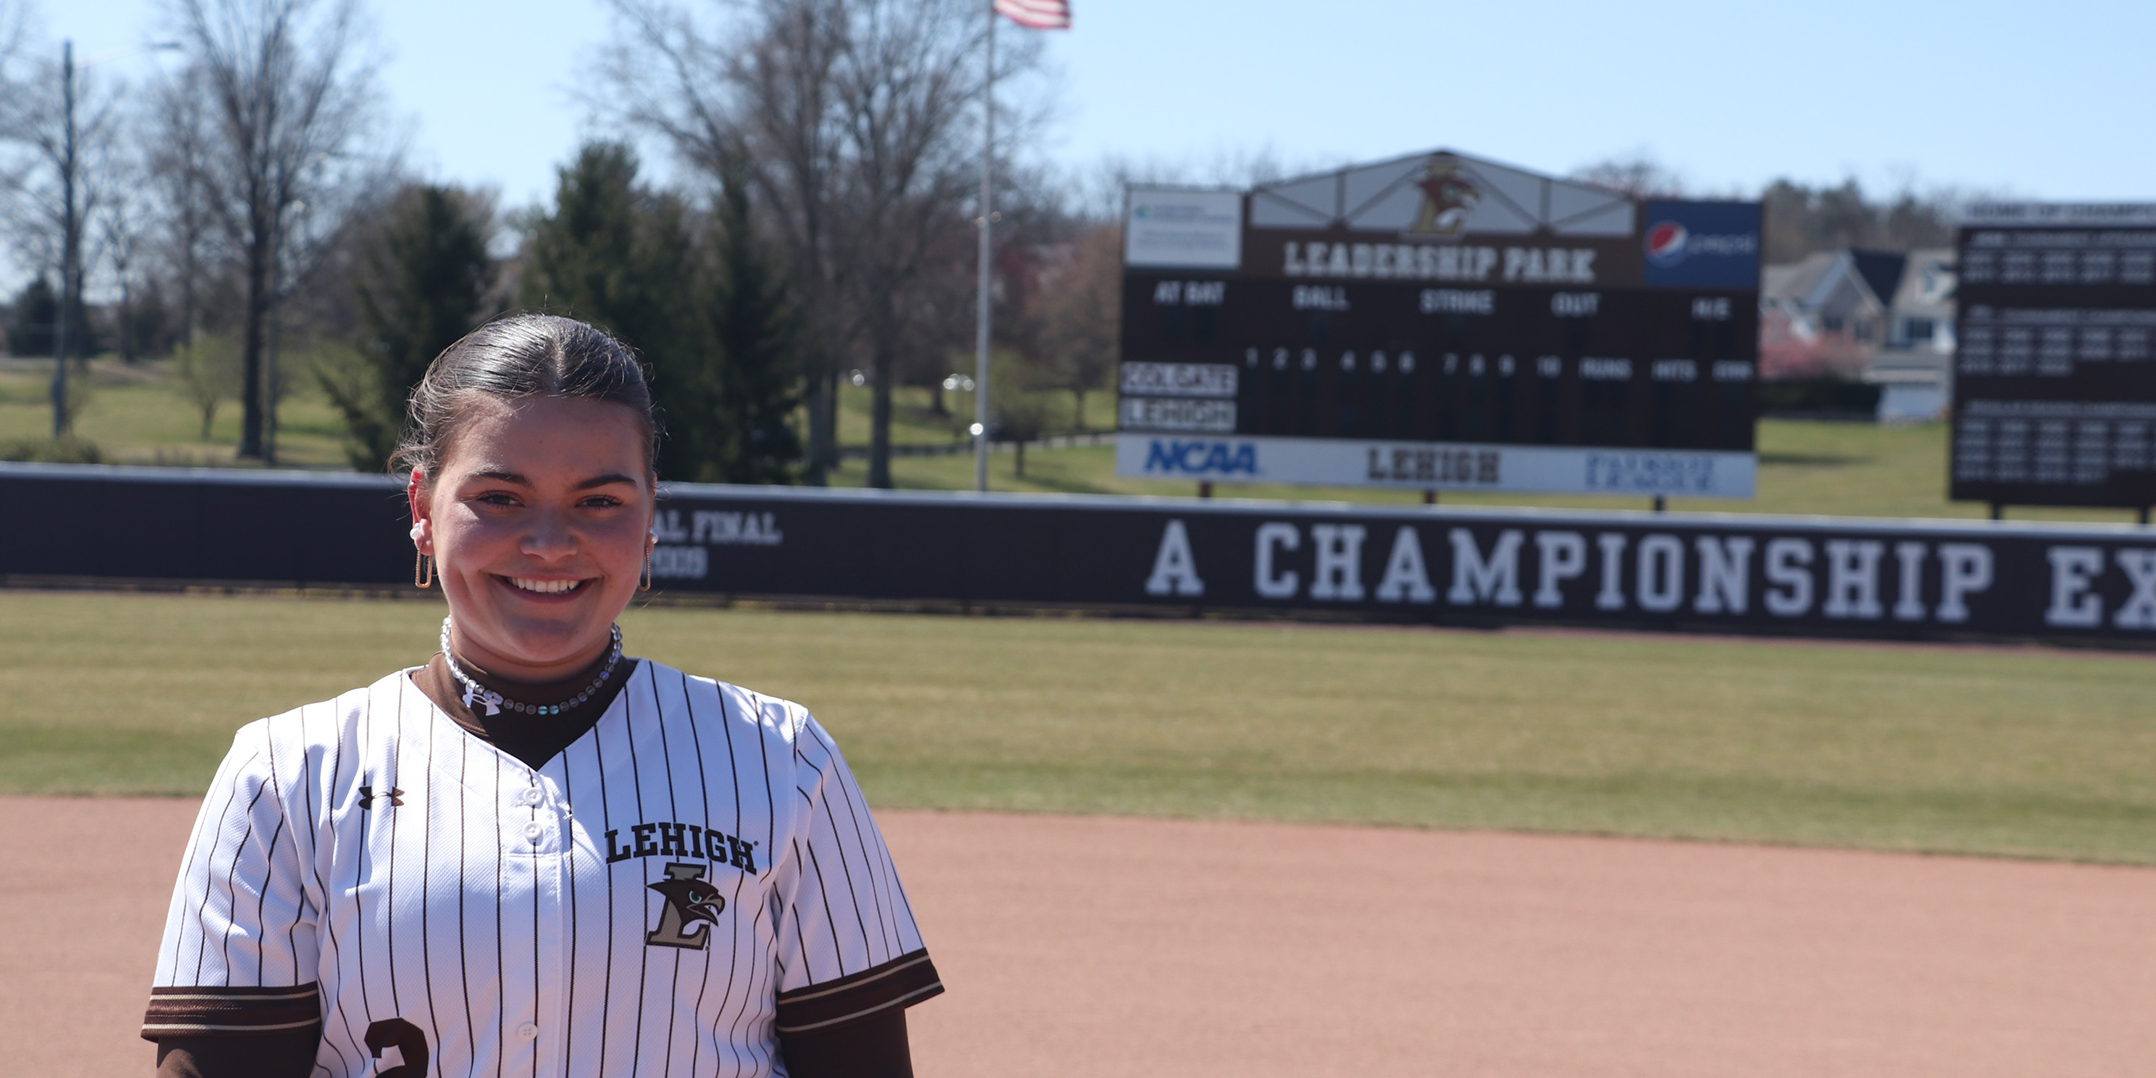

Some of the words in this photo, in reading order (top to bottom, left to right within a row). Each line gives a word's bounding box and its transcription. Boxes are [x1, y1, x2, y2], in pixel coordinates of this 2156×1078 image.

[1286, 242, 1496, 280] LEADERSHIP
[1503, 248, 1596, 282] PARK
[1154, 281, 1181, 303] AT
[1184, 281, 1225, 304] BAT
[1293, 285, 1349, 310] BALL
[1420, 289, 1496, 315] STRIKE
[1552, 292, 1600, 317] OUT
[1273, 348, 1288, 370] 2
[1122, 401, 1234, 425] LEHIGH
[1146, 440, 1258, 475] NCAA
[1366, 448, 1500, 484] LEHIGH
[692, 511, 782, 545] FINAL
[1145, 518, 1204, 595] A
[1253, 521, 1995, 622] CHAMPIONSHIP
[604, 821, 757, 876] LEHIGH
